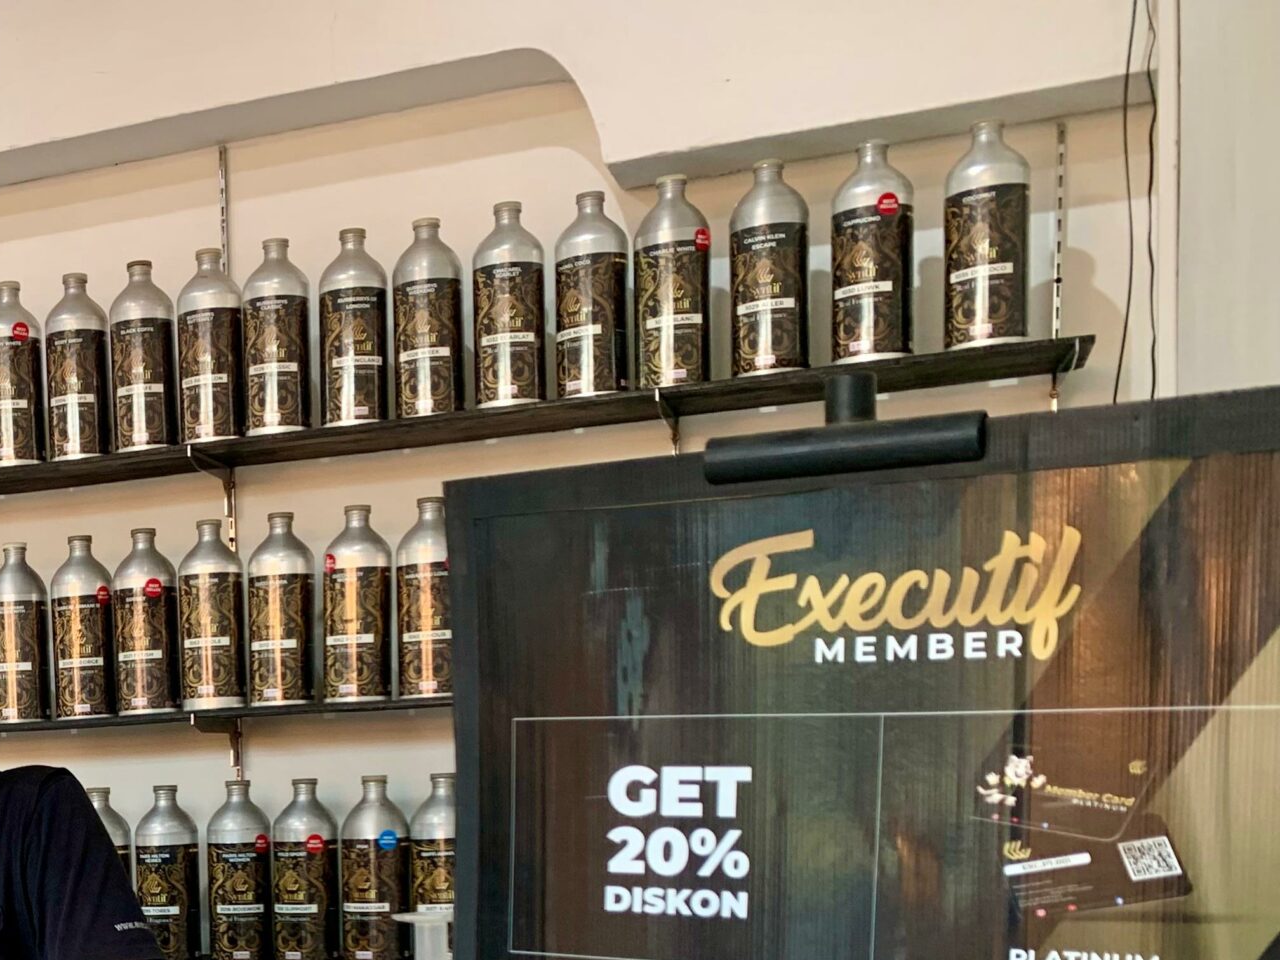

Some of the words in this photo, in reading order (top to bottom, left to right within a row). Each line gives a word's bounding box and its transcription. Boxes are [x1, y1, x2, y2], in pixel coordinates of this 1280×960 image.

[743, 235, 765, 245] CALVIN
[710, 525, 1081, 660] Executif
[814, 630, 1024, 663] MEMBER
[607, 764, 752, 819] GET
[1102, 793, 1136, 807] Card
[606, 826, 750, 880] 20%
[603, 884, 749, 920] DISKON
